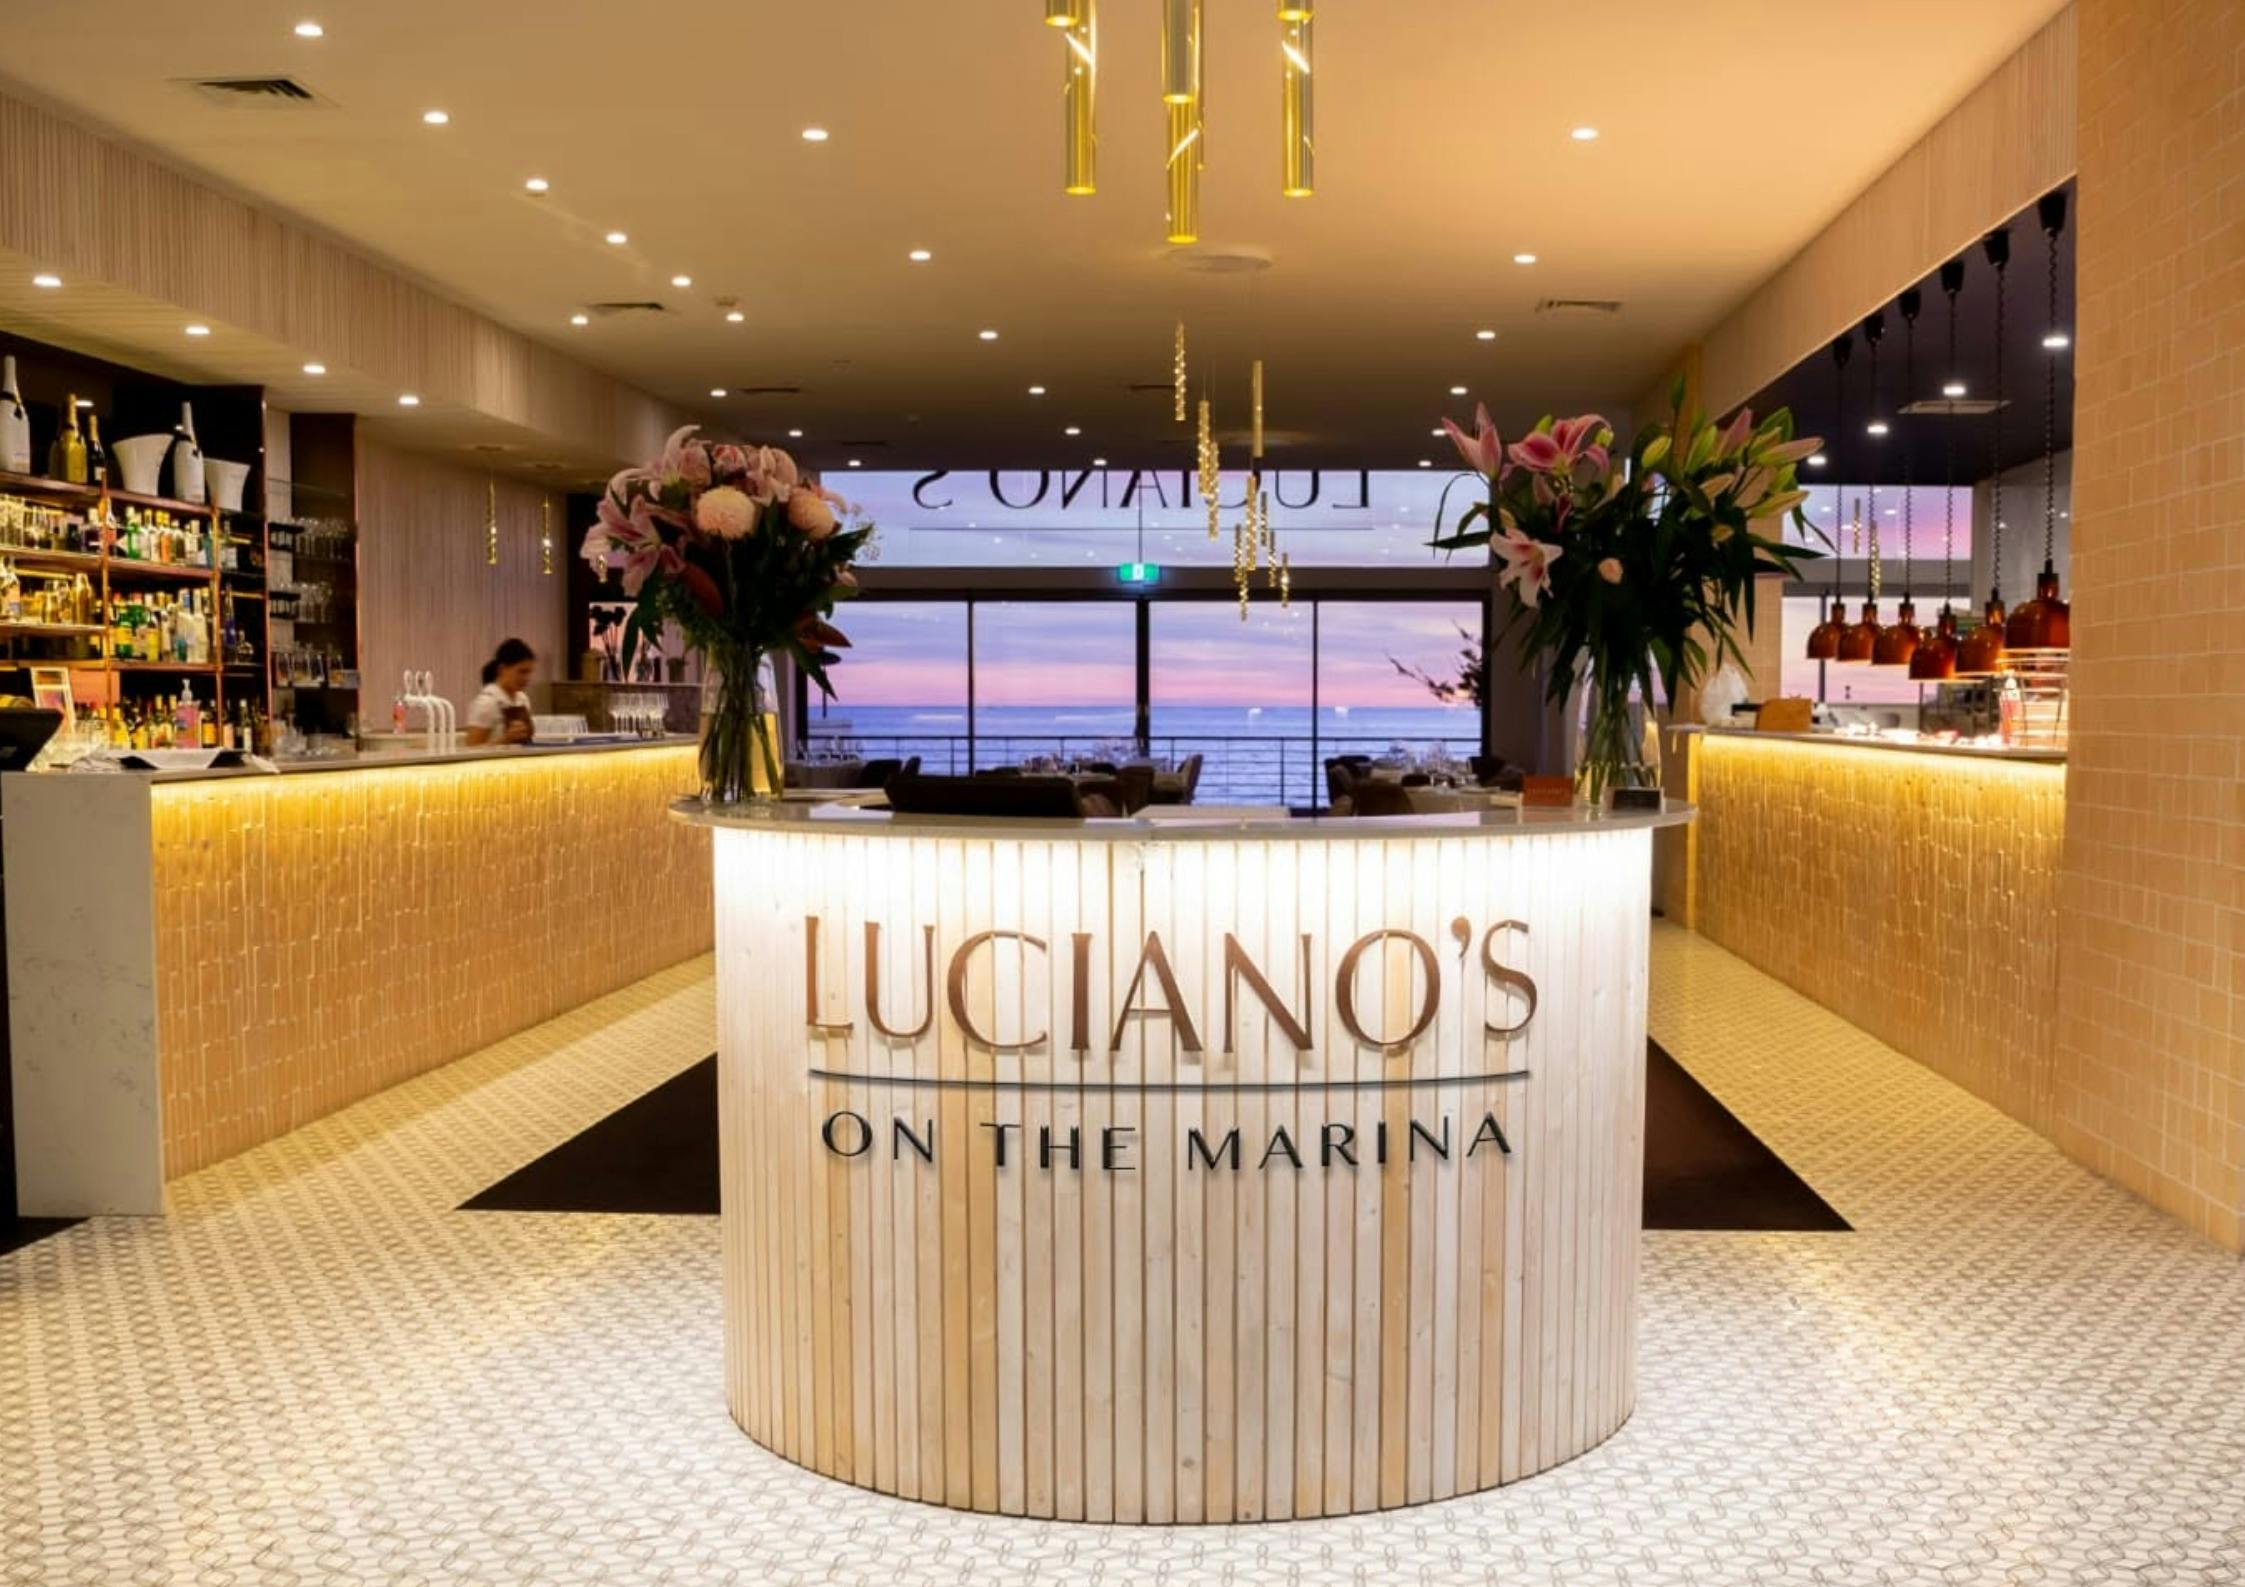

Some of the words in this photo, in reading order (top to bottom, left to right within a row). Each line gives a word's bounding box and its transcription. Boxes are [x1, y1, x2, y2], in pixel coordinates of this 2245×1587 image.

[805, 915, 1538, 1053] LUCIANO'S
[821, 1110, 934, 1163] ON
[979, 1121, 1137, 1171] THE
[1187, 1110, 1513, 1171] MARINA
